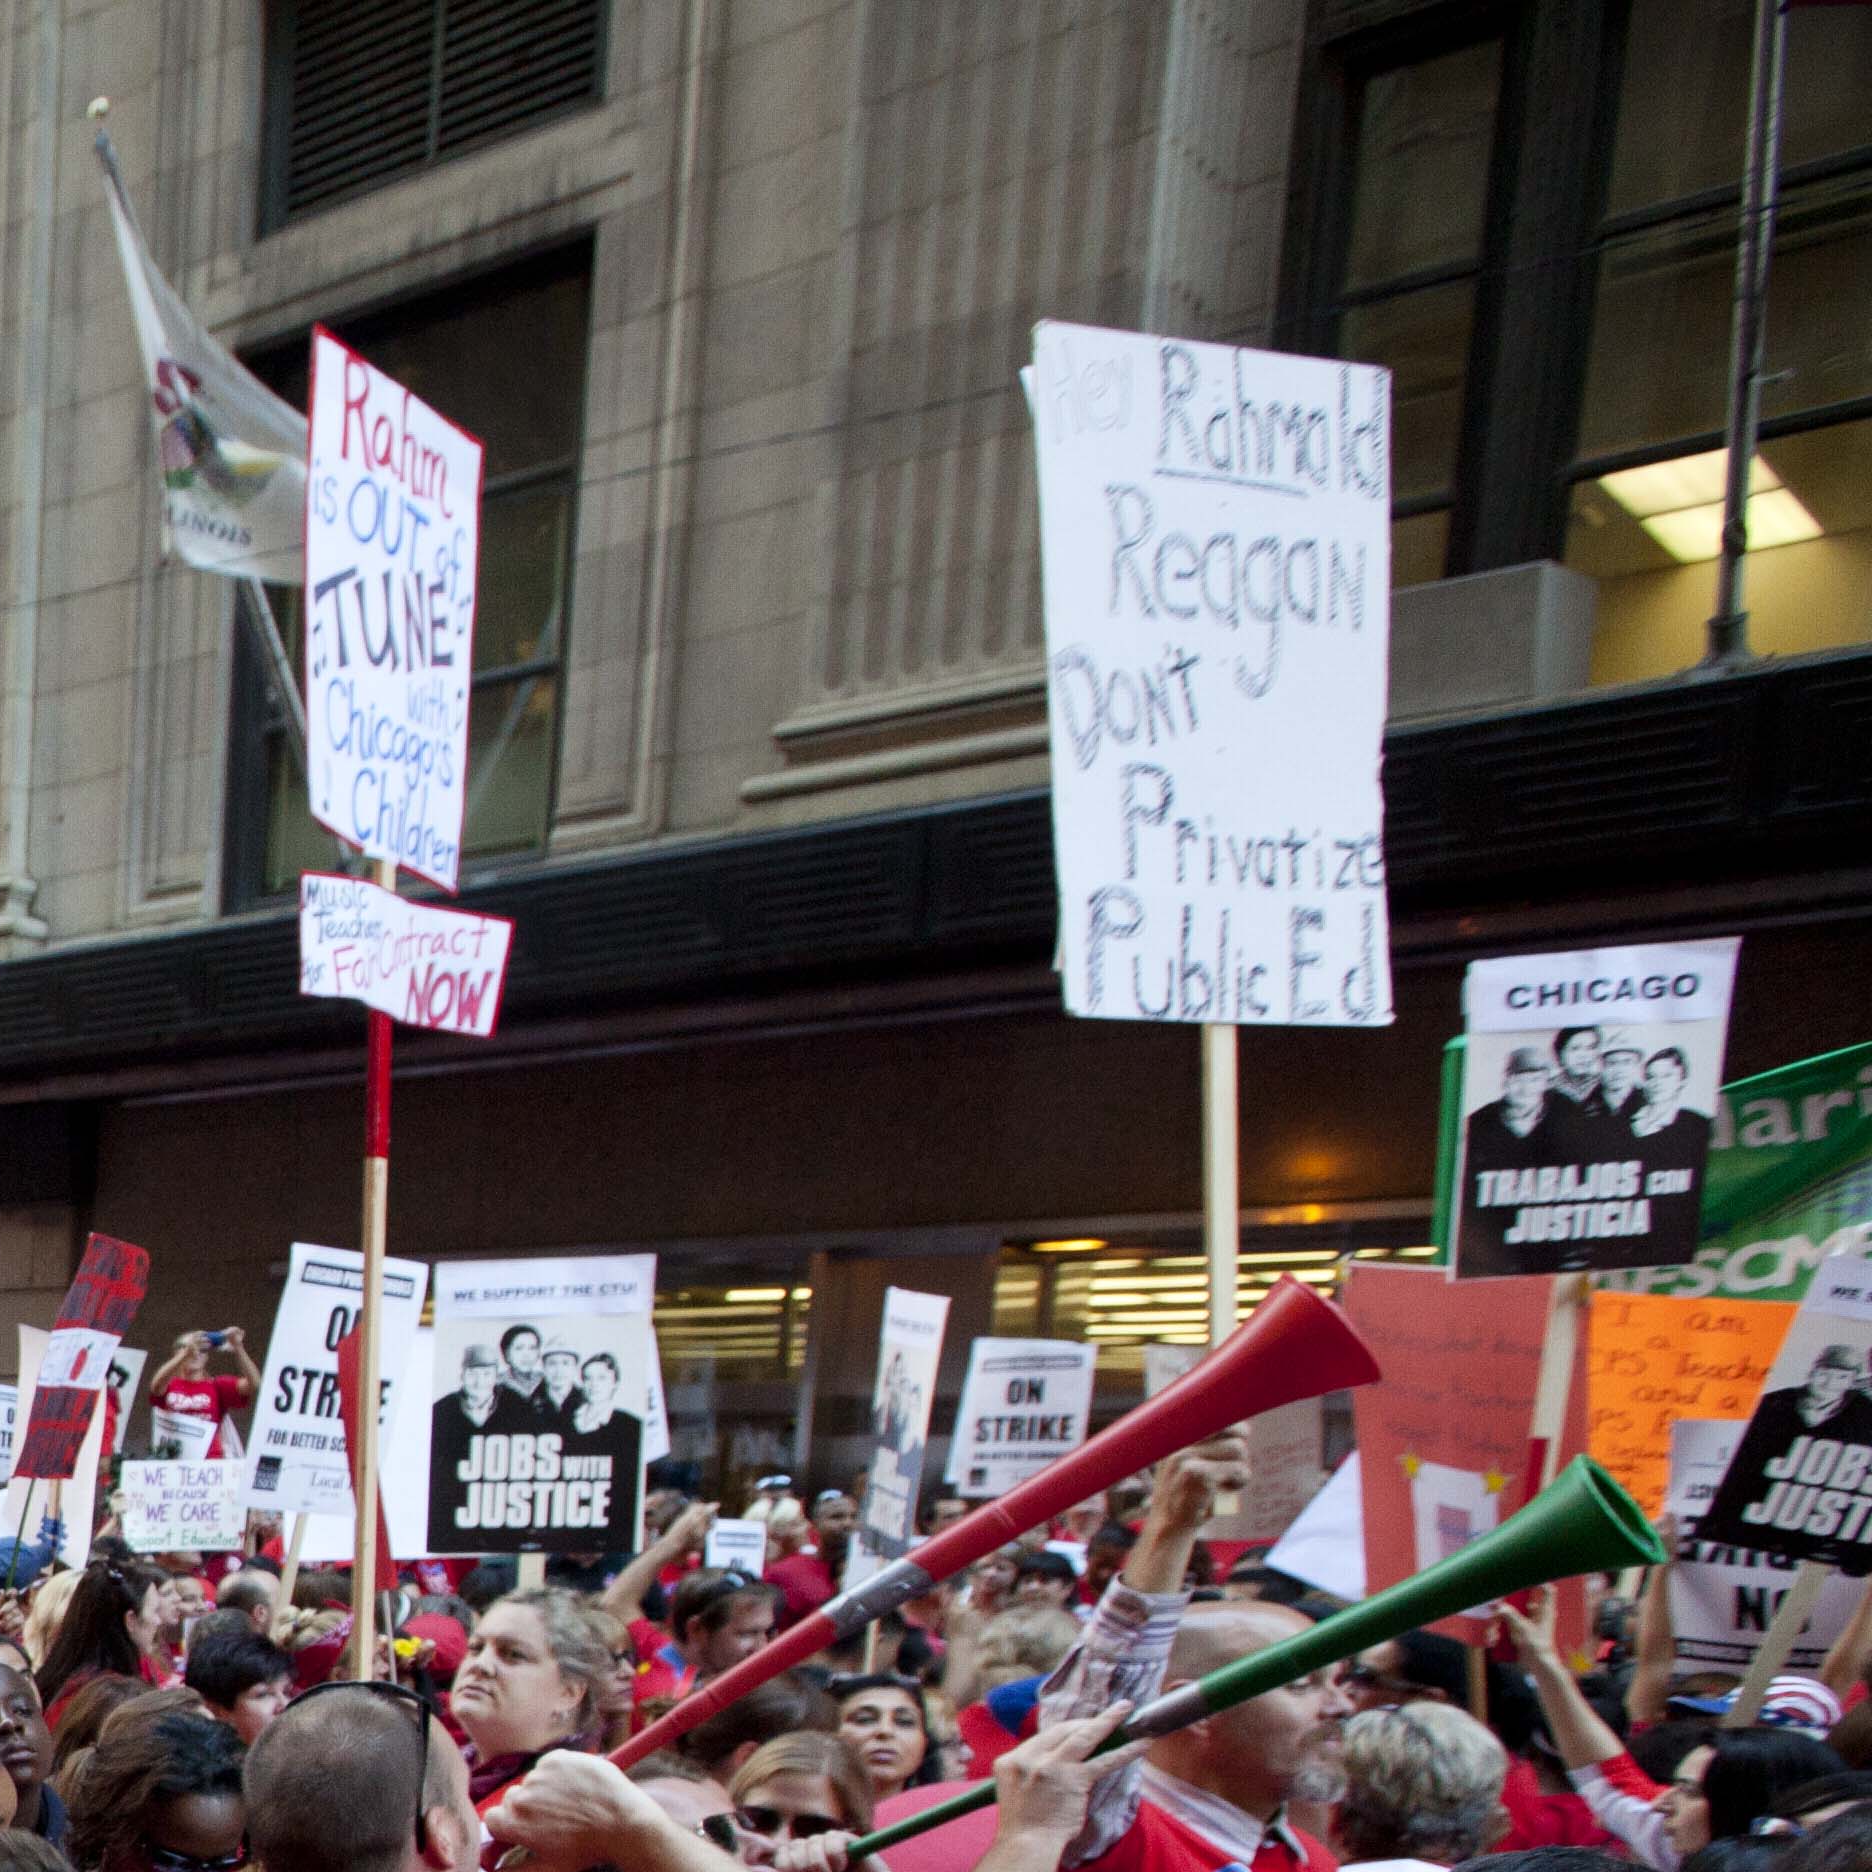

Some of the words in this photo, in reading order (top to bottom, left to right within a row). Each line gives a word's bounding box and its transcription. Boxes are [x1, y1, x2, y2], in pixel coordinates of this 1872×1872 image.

[340, 353, 453, 520] Rahm
[314, 458, 339, 527] is
[347, 476, 431, 574] OUT
[435, 525, 467, 604] of
[1104, 483, 1368, 699] Reagan
[313, 567, 456, 674] TUNE
[326, 677, 454, 791] Chicago's
[352, 767, 456, 874] Children
[1121, 761, 1387, 890] Privatize
[305, 881, 370, 911] Music
[1085, 884, 1268, 1018] Public
[1287, 900, 1388, 1022] Ed
[405, 963, 496, 1031] NOW
[1505, 972, 1702, 1011] CHICAGO
[1475, 1159, 1644, 1209] TRABAJOS
[1503, 1198, 1652, 1245] JUSTICIA
[453, 1288, 479, 1301] WE
[482, 1284, 556, 1300] SUPPORT
[562, 1284, 594, 1297] THE
[598, 1281, 639, 1297] CTU!
[1005, 1375, 1046, 1406] ON
[266, 1427, 287, 1445] FOR
[290, 1429, 328, 1450] BETTER
[973, 1414, 1075, 1443] STRIKE
[143, 1466, 166, 1487] WE
[177, 1464, 224, 1487] TEACH
[456, 1432, 564, 1483] JOBS
[1762, 1434, 1872, 1497] JOB
[146, 1502, 167, 1523] WE
[179, 1501, 223, 1523] CARE
[162, 1489, 209, 1501] BECAUSE
[454, 1480, 613, 1530] JUSTICE
